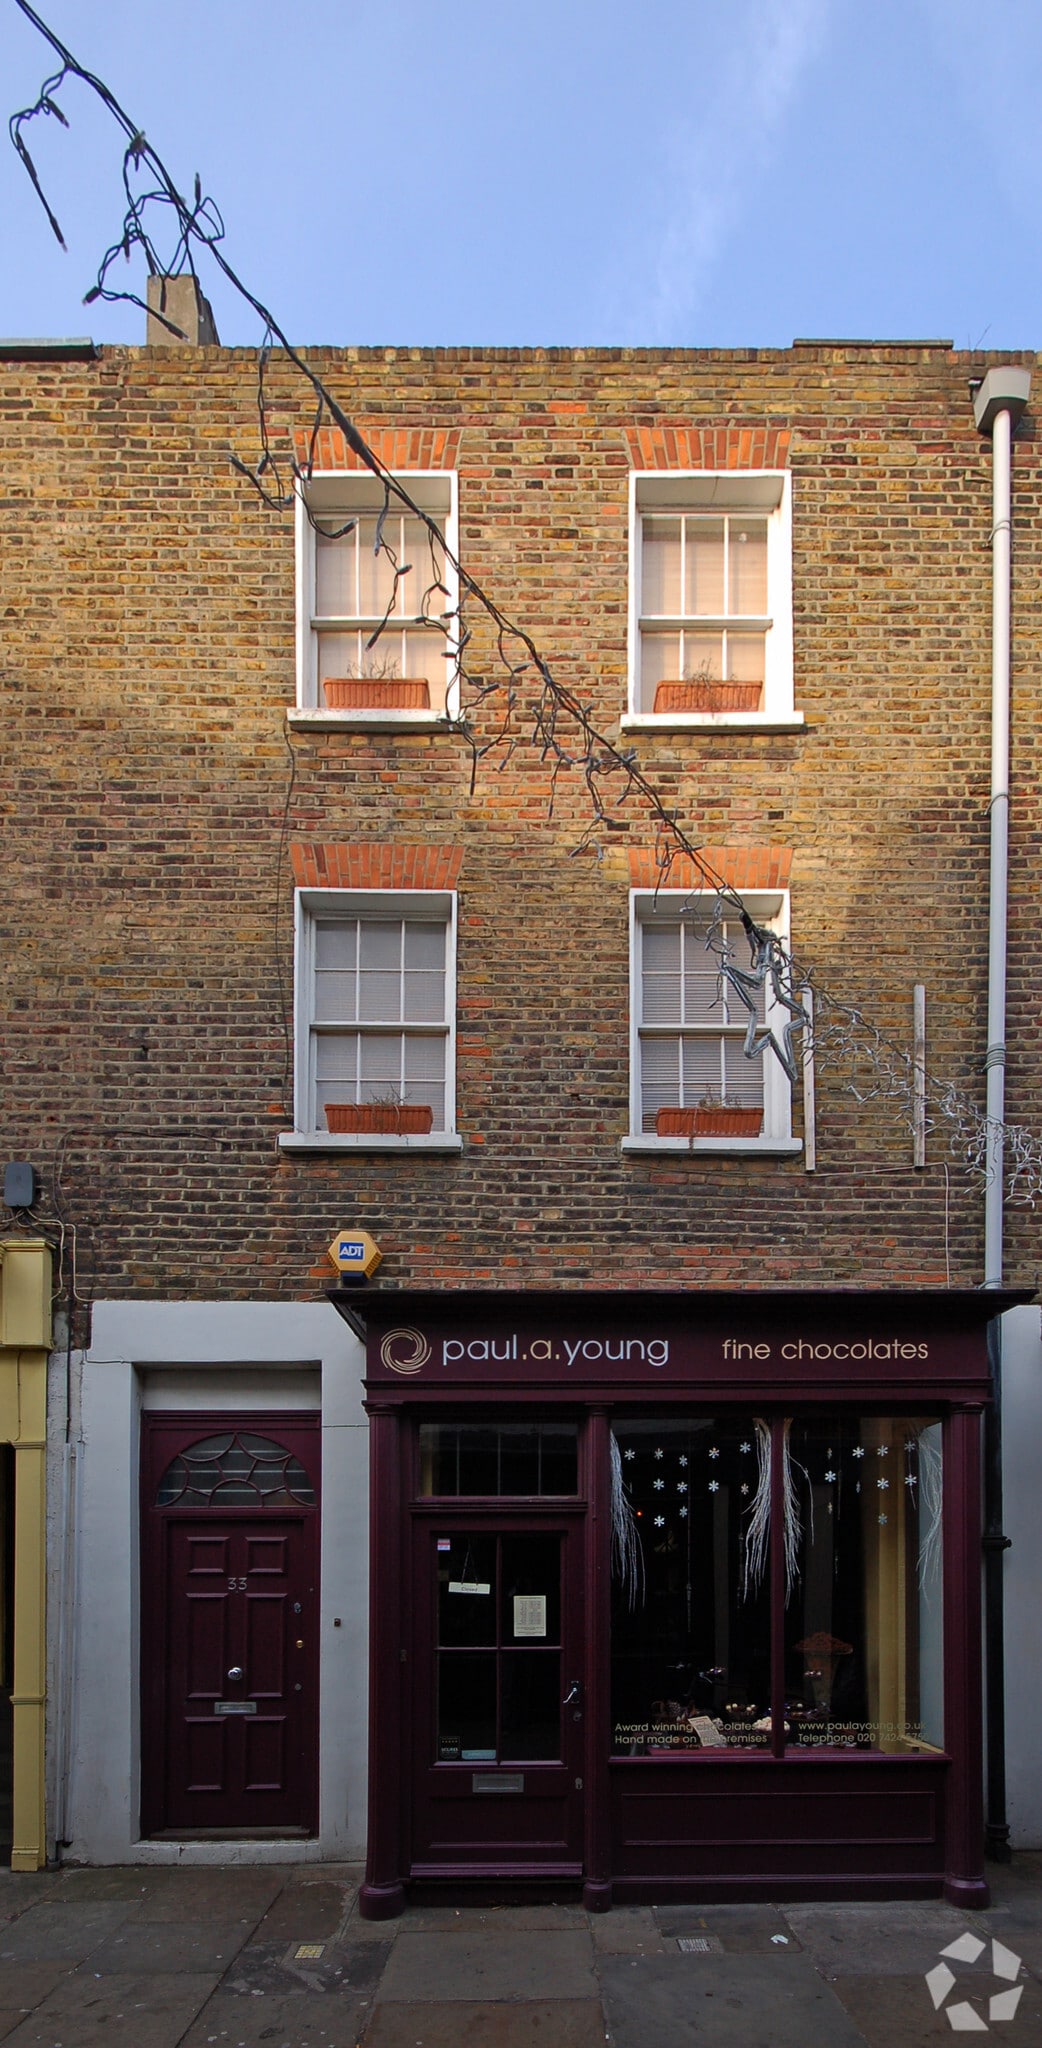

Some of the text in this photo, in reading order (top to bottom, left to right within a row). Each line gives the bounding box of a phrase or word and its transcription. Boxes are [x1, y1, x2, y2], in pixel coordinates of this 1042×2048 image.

[339, 1245, 365, 1257] ADT
[442, 1334, 669, 1367] paul.a.young
[721, 1338, 929, 1360] fine chocolates
[227, 1577, 248, 1590] 33
[614, 1722, 649, 1732] Award
[651, 1722, 693, 1734] winning
[798, 1721, 927, 1732] www.paulayoung.co.uk
[614, 1734, 646, 1744] Hand
[646, 1734, 681, 1744] made
[682, 1736, 697, 1744] on
[719, 1734, 768, 1746] premises
[798, 1733, 855, 1744] Telephone
[857, 1733, 876, 1742] 020
